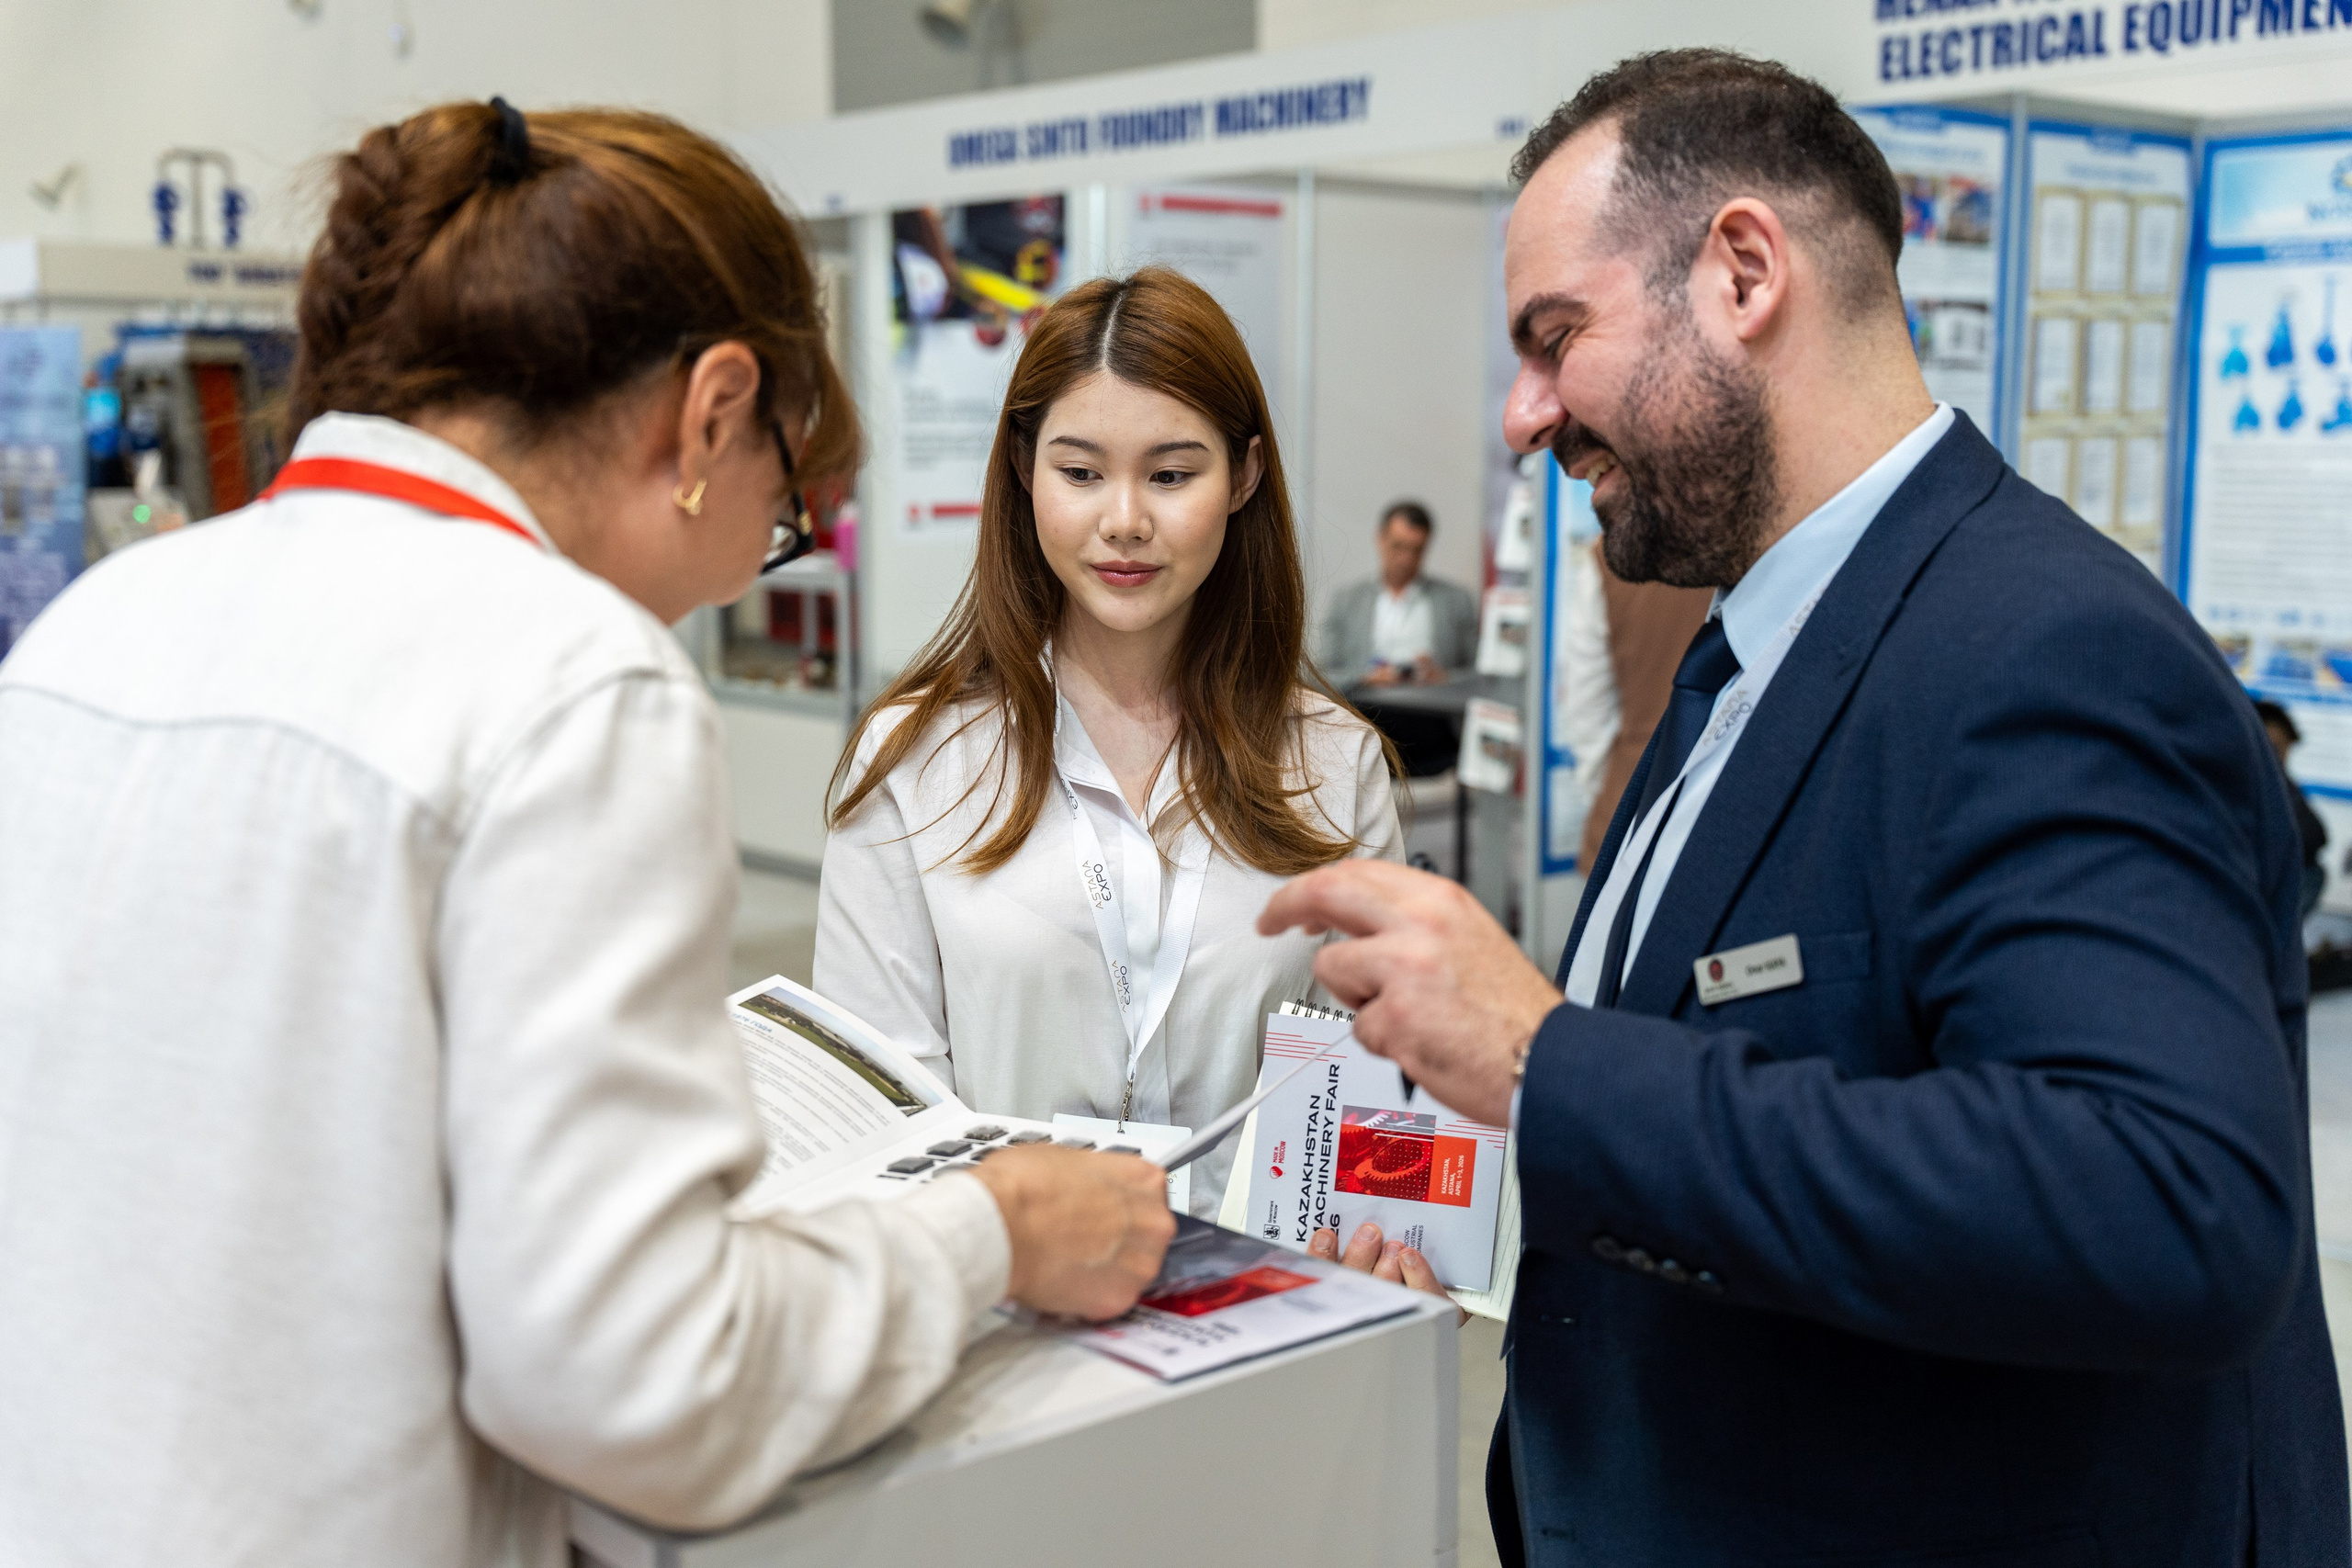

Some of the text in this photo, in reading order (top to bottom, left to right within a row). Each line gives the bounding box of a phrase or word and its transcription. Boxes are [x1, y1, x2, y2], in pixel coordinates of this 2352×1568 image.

[1880, 9, 2107, 83] ELECTRICAL
[947, 129, 1017, 169] OMEGA
[1099, 101, 1204, 152] FOUNDRY
[1215, 76, 1371, 135] MACHINERY
[1713, 701, 1751, 741] EXPO
[1081, 860, 1103, 909] ASTANA
[1093, 863, 1112, 901] EXPO
[1112, 960, 1126, 1012] ASTANA
[1119, 965, 1131, 1005] EXPO
[1326, 1063, 1340, 1111] FAIR
[1278, 1141, 1286, 1164] MOSCOW
[1296, 1094, 1321, 1242] KAZAKHSTAN
[1441, 1157, 1451, 1194] KAZAKHSTAN,
[1448, 1172, 1456, 1195] ASTANA,
